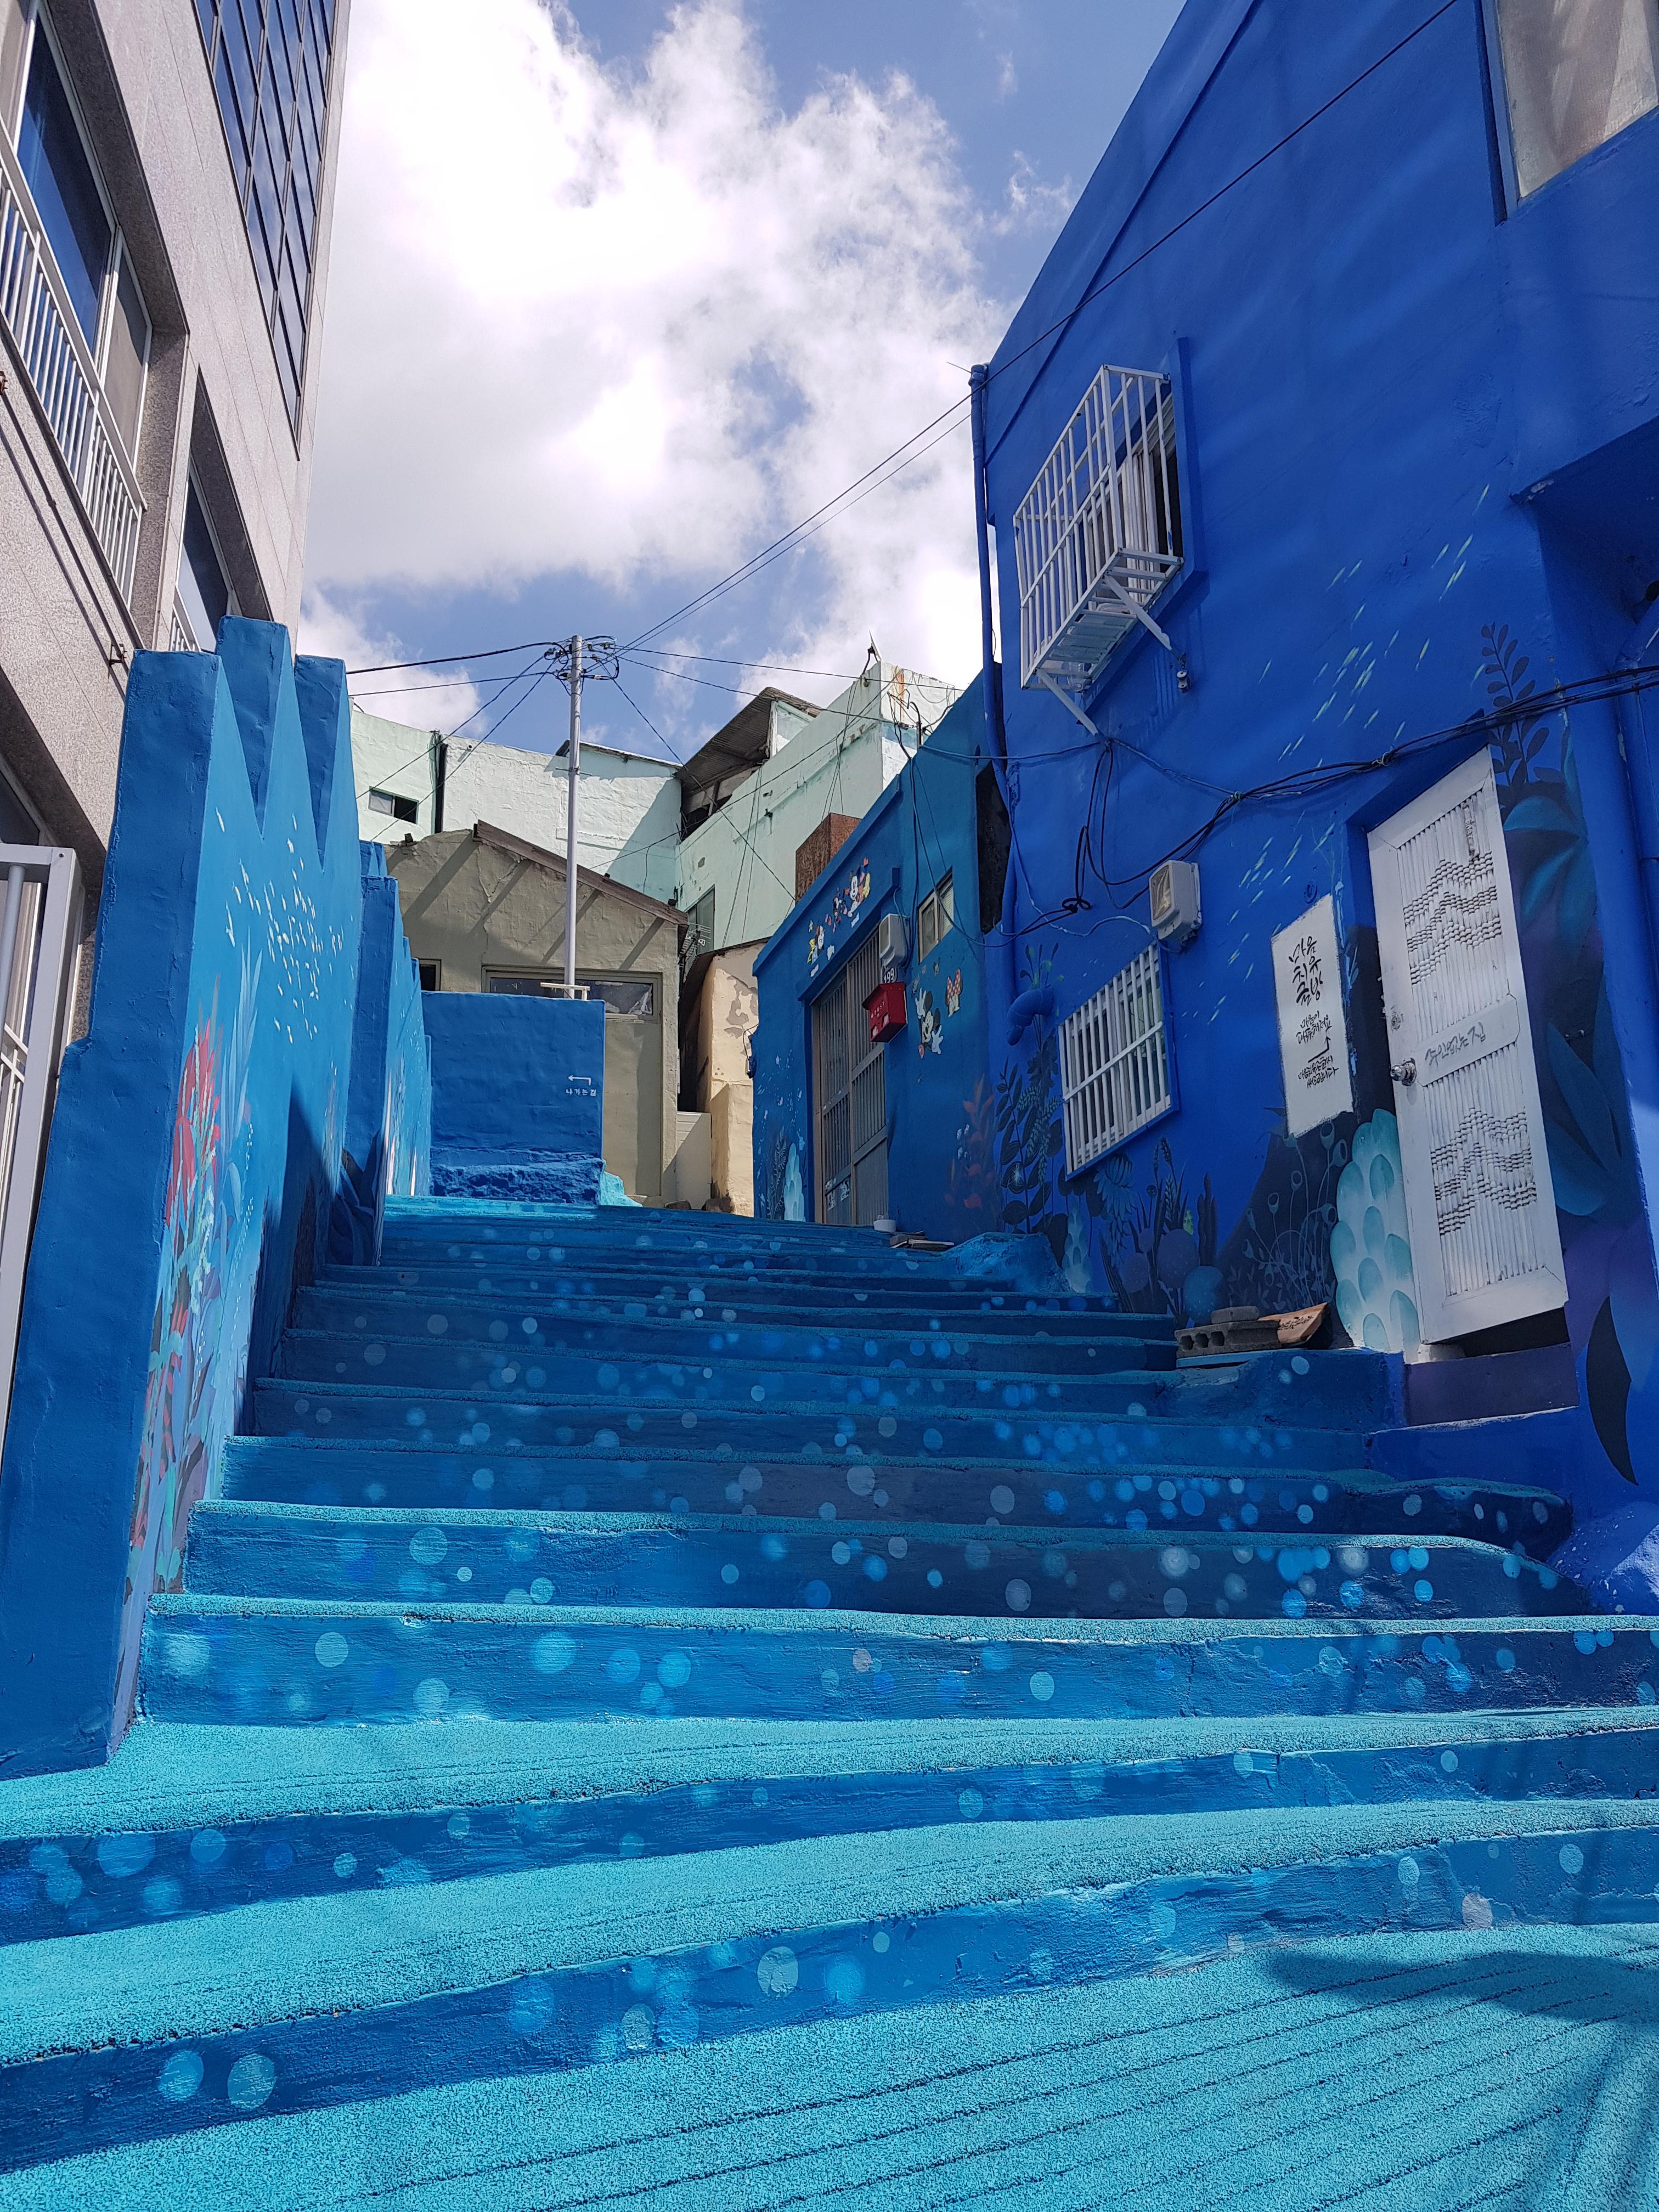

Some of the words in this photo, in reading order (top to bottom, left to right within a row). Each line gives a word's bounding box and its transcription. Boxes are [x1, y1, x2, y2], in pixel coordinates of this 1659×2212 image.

[1289, 936, 1317, 964] 마음
[1293, 956, 1322, 984] 치유
[1296, 970, 1323, 1006] 글방
[1300, 1011, 1319, 1028] 마음이
